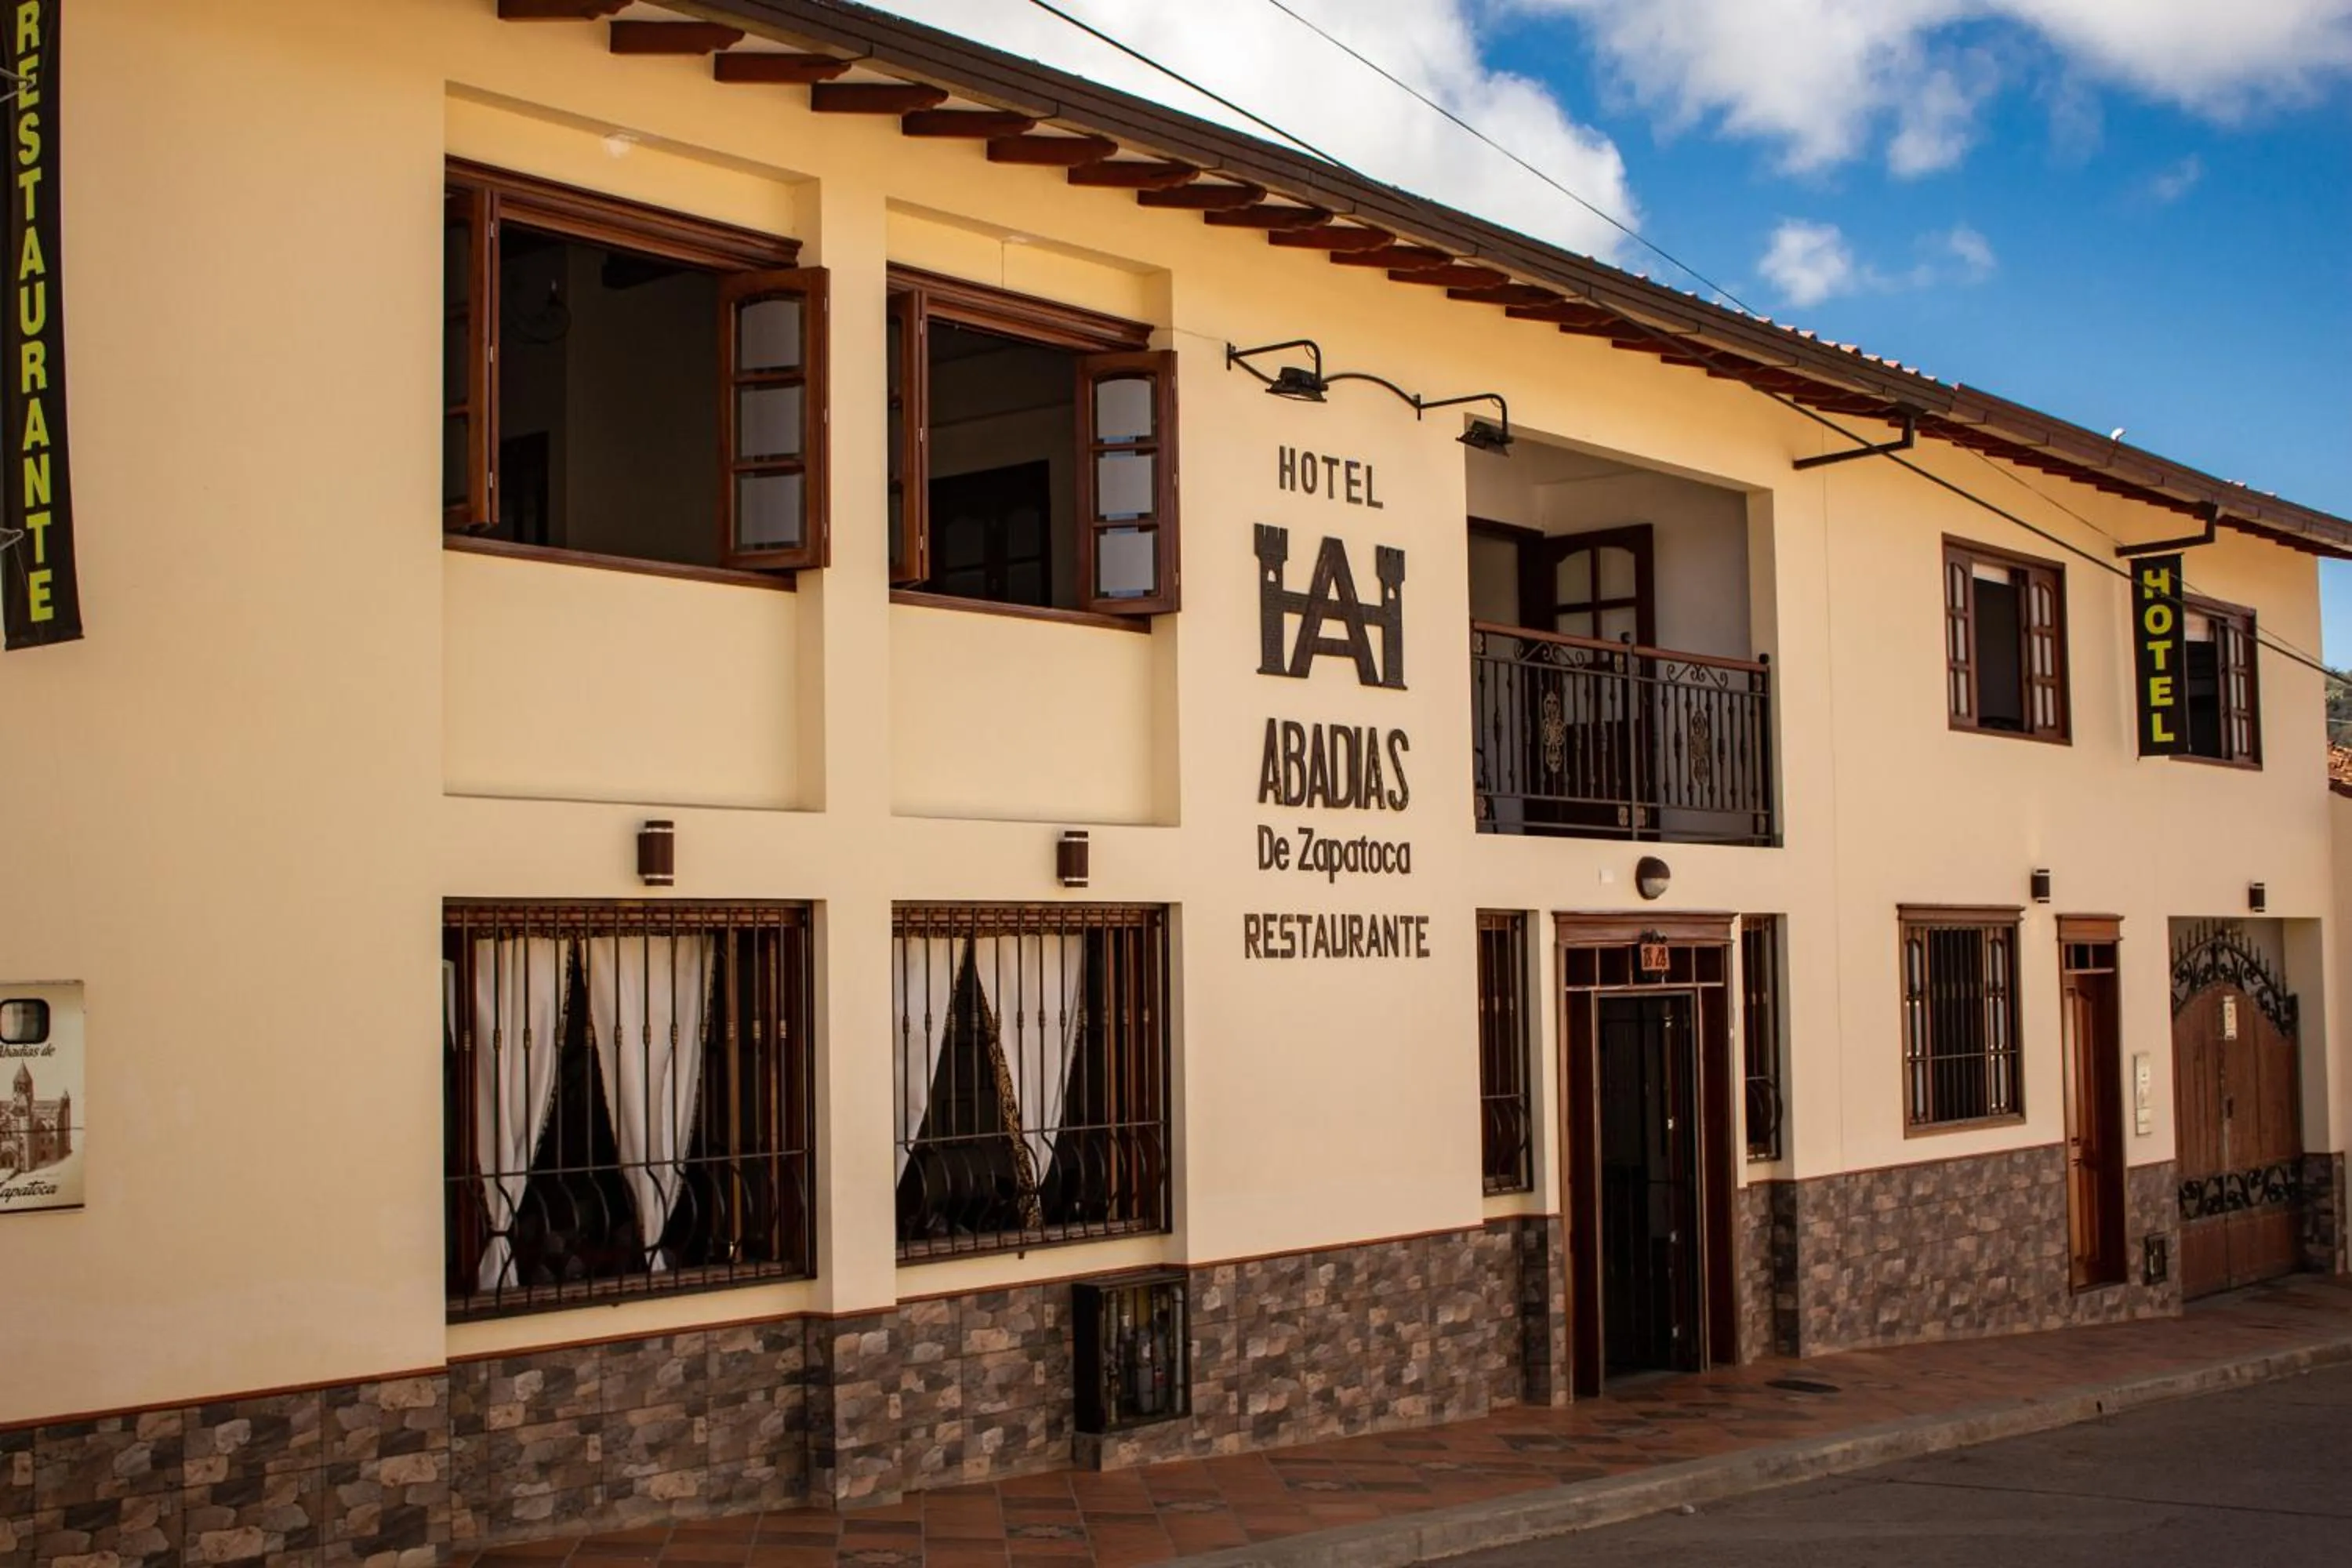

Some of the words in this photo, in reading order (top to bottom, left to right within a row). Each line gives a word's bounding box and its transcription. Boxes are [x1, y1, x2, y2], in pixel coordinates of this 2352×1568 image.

[16, 0, 54, 622] RESTAURANTE
[1279, 445, 1384, 509] HOTEL
[2143, 567, 2175, 742] HOTEL
[1258, 717, 1410, 811] ABADIAS
[1258, 824, 1290, 871] De
[1298, 827, 1411, 884] Zapatoca
[1243, 913, 1431, 959] RESTAURANTE
